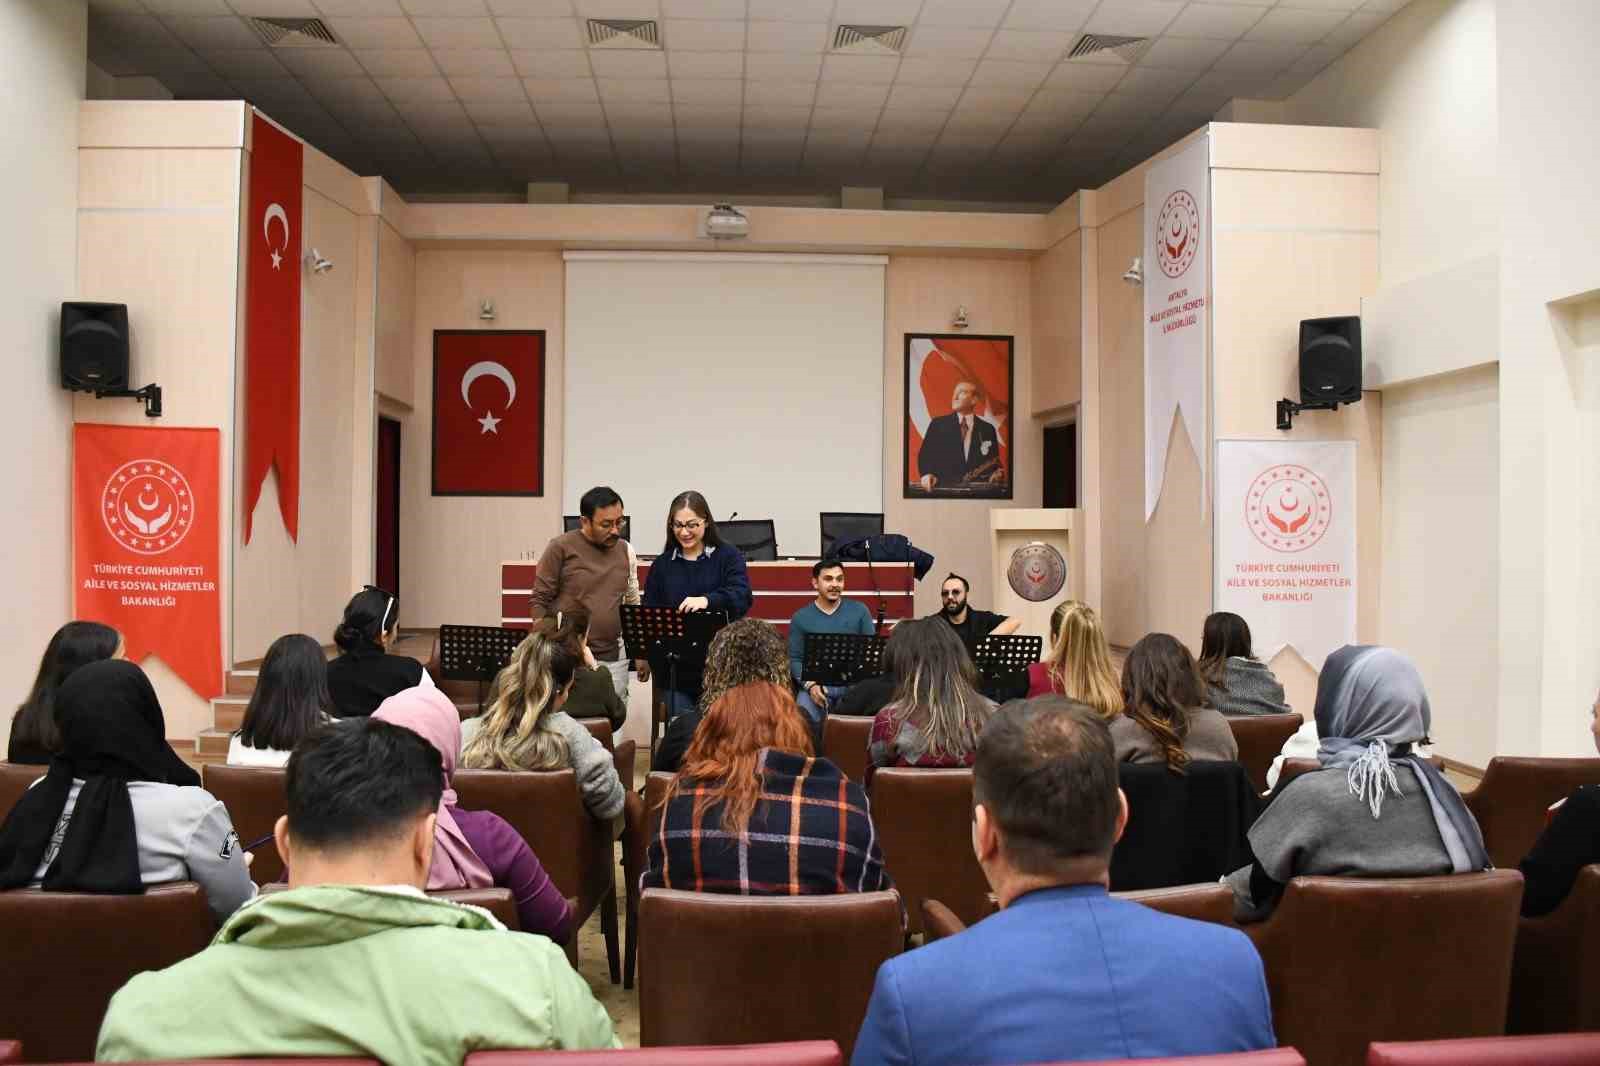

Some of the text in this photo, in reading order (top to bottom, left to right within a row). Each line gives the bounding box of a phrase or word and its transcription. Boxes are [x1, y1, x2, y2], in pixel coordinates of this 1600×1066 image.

[94, 563, 203, 576] TÜRKİYE CUMHURİYETİ
[1235, 562, 1340, 573] TÜRKİYE CUMHURİYETİ
[84, 578, 216, 592] AİLE VE SOSYAL HİZMETLER
[1226, 577, 1352, 588] AİLE VE SOSYAL HİZMETLER
[121, 595, 176, 607] BAKANLIĞI
[1262, 591, 1313, 602] BAKANLIĞI
